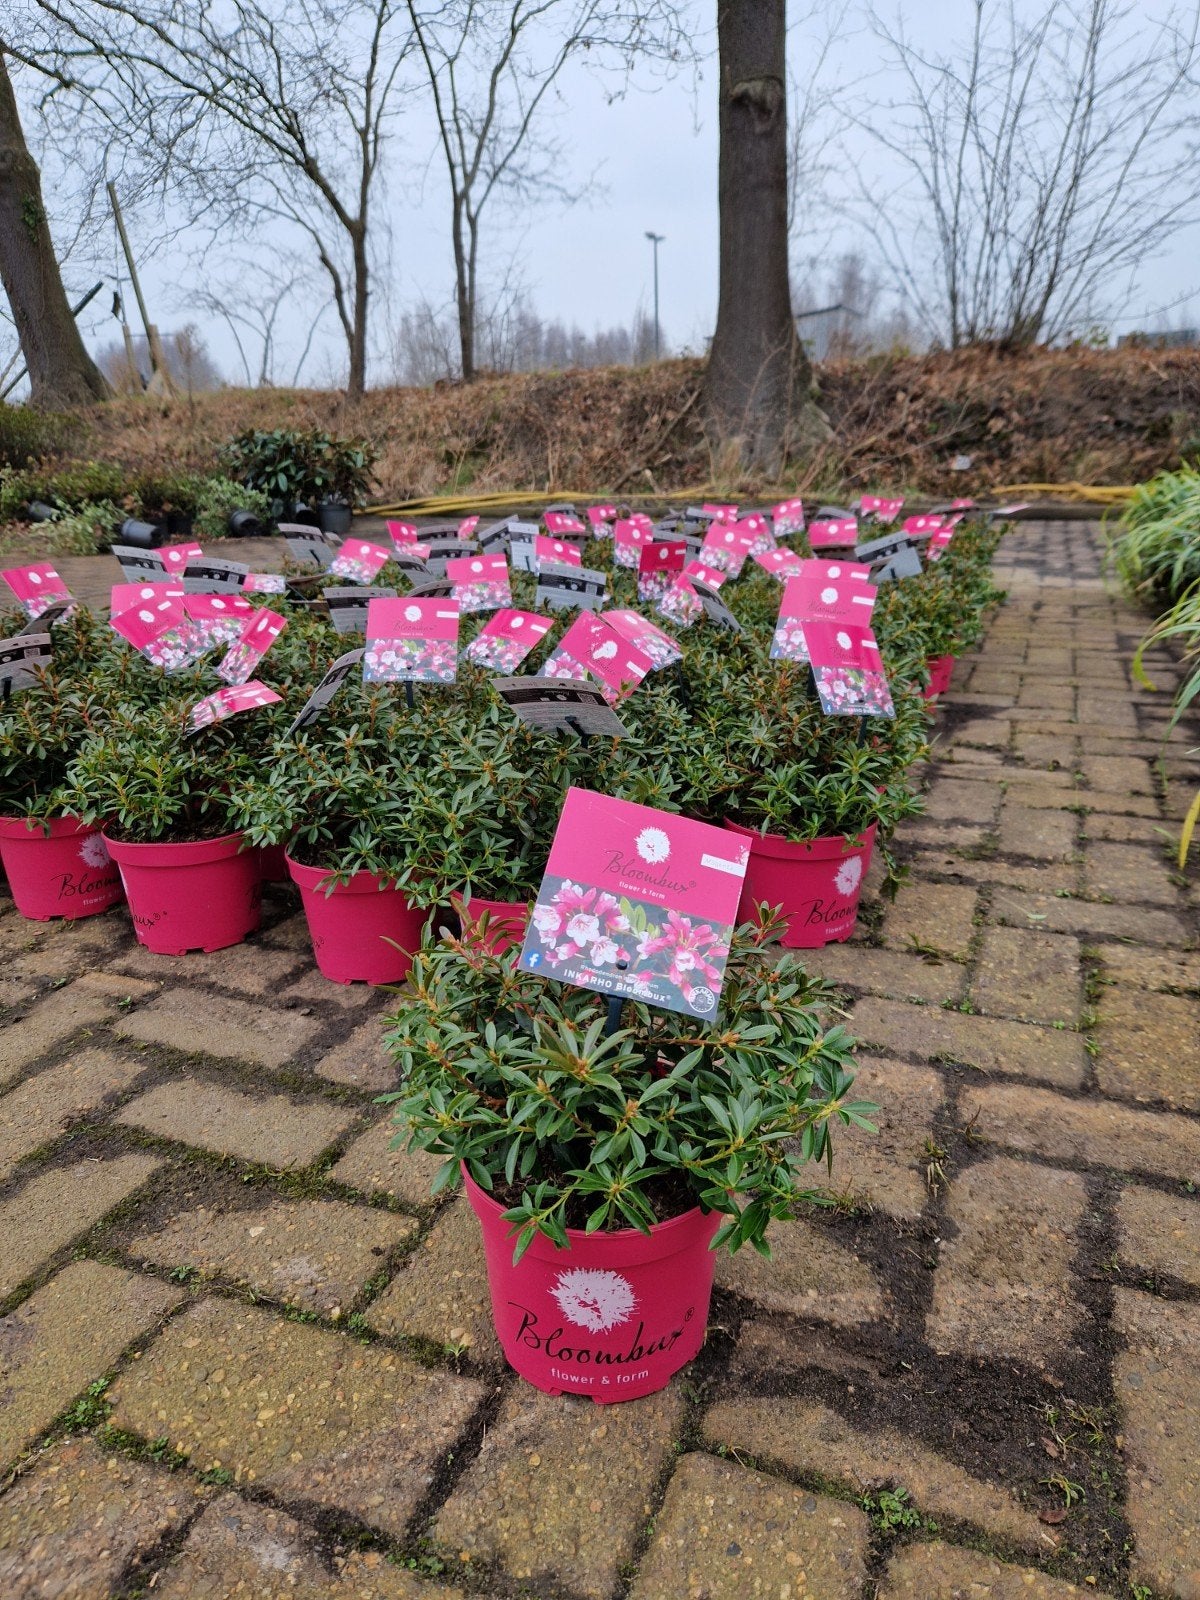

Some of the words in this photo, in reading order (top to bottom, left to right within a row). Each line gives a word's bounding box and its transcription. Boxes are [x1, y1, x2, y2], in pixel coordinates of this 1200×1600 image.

[619, 881, 640, 892] flower
[648, 889, 666, 900] form
[563, 968, 613, 989] INKARHO
[551, 1367, 595, 1385] flower
[601, 1375, 611, 1385] &
[616, 1369, 649, 1384] form
